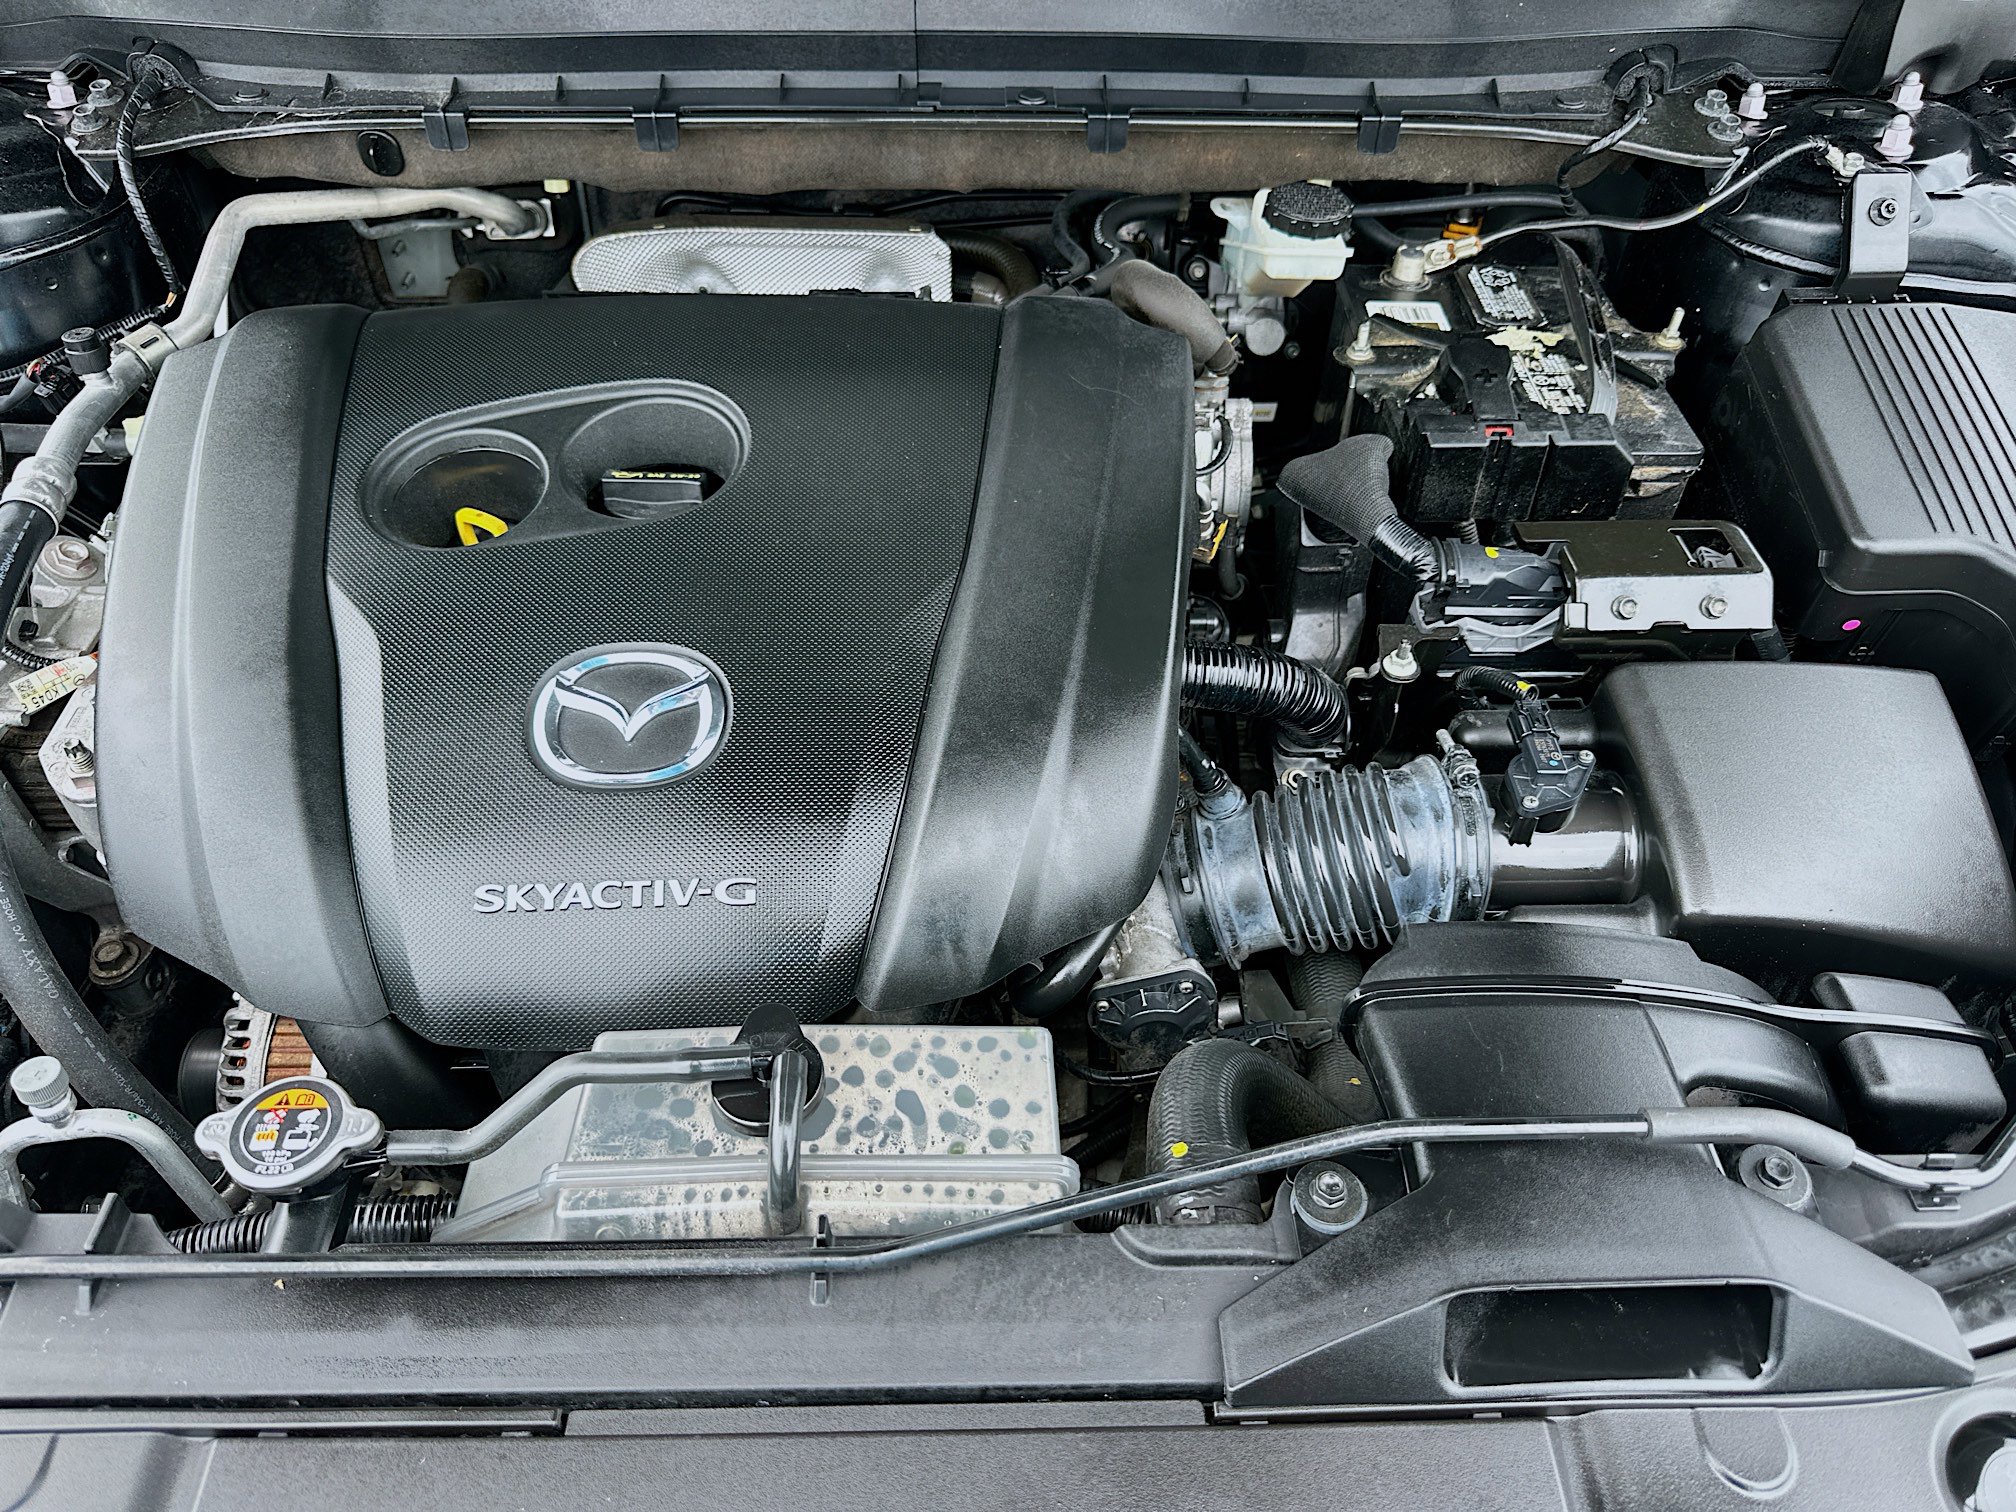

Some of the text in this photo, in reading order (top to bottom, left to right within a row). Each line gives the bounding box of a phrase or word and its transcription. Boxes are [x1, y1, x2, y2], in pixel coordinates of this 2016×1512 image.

[31, 687, 60, 708] KD45
[473, 877, 757, 913] SKYACTIV-G
[0, 897, 17, 922] HOSE
[12, 924, 27, 942] A/C
